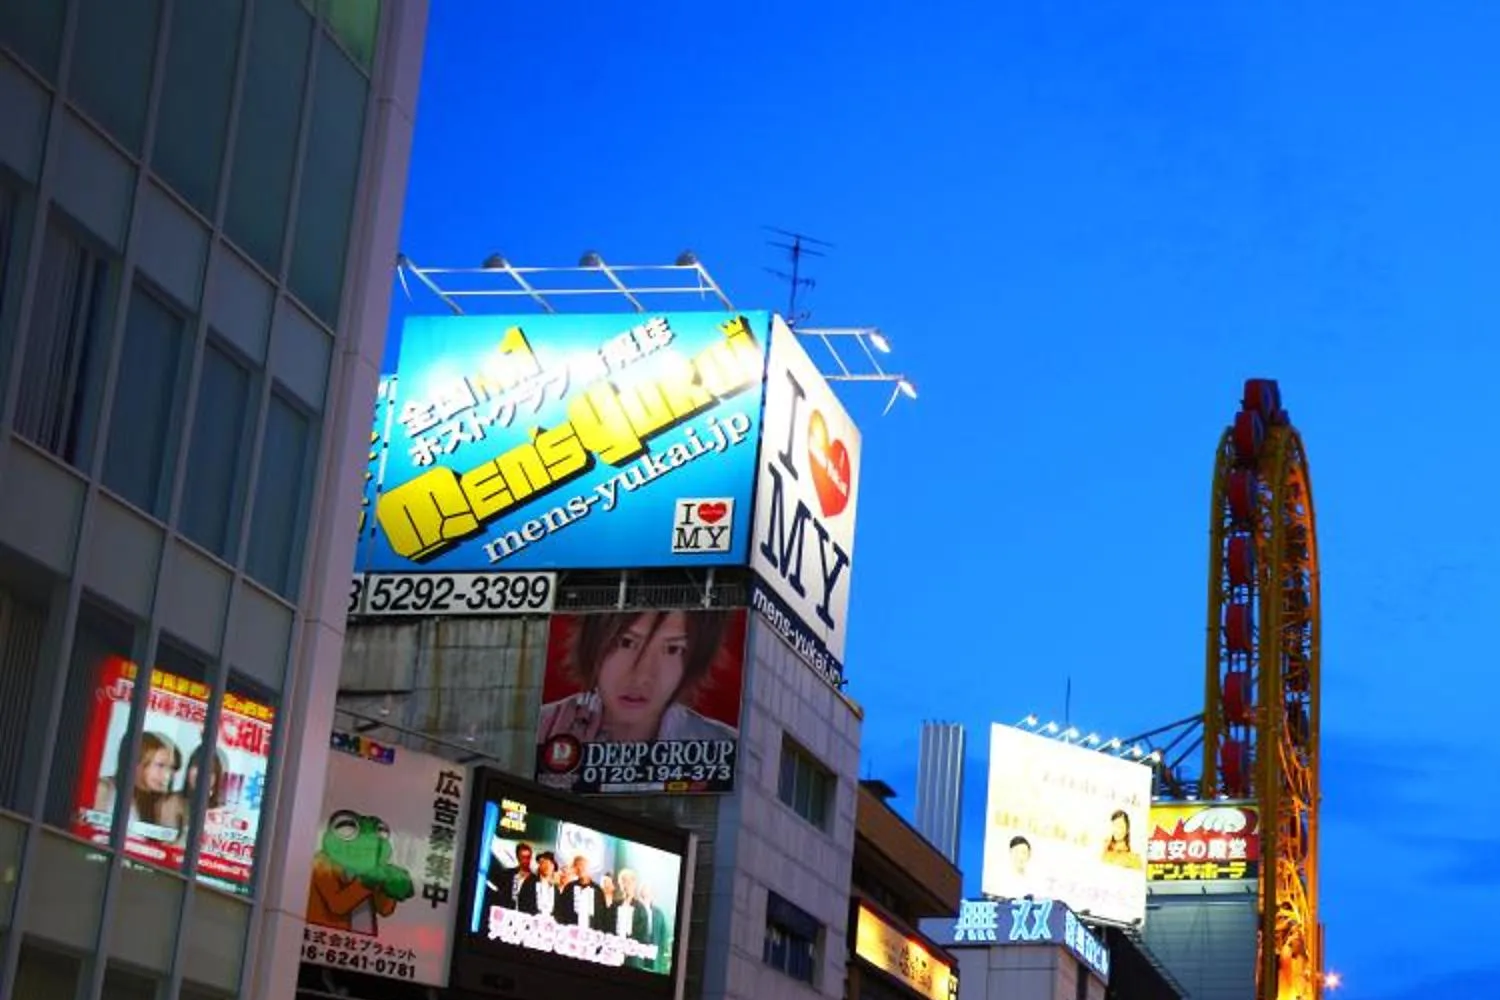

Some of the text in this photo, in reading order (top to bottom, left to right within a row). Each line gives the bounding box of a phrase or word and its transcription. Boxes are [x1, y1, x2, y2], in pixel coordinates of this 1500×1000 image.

[482, 408, 754, 564] mens-yukai.jp
[673, 526, 728, 550] MY
[760, 461, 849, 630] MY
[370, 576, 551, 611] 5292-3399
[585, 740, 734, 767] DEEP GROUP
[583, 765, 732, 783] 0120-194-373
[301, 944, 416, 979] 6-6241-0781
